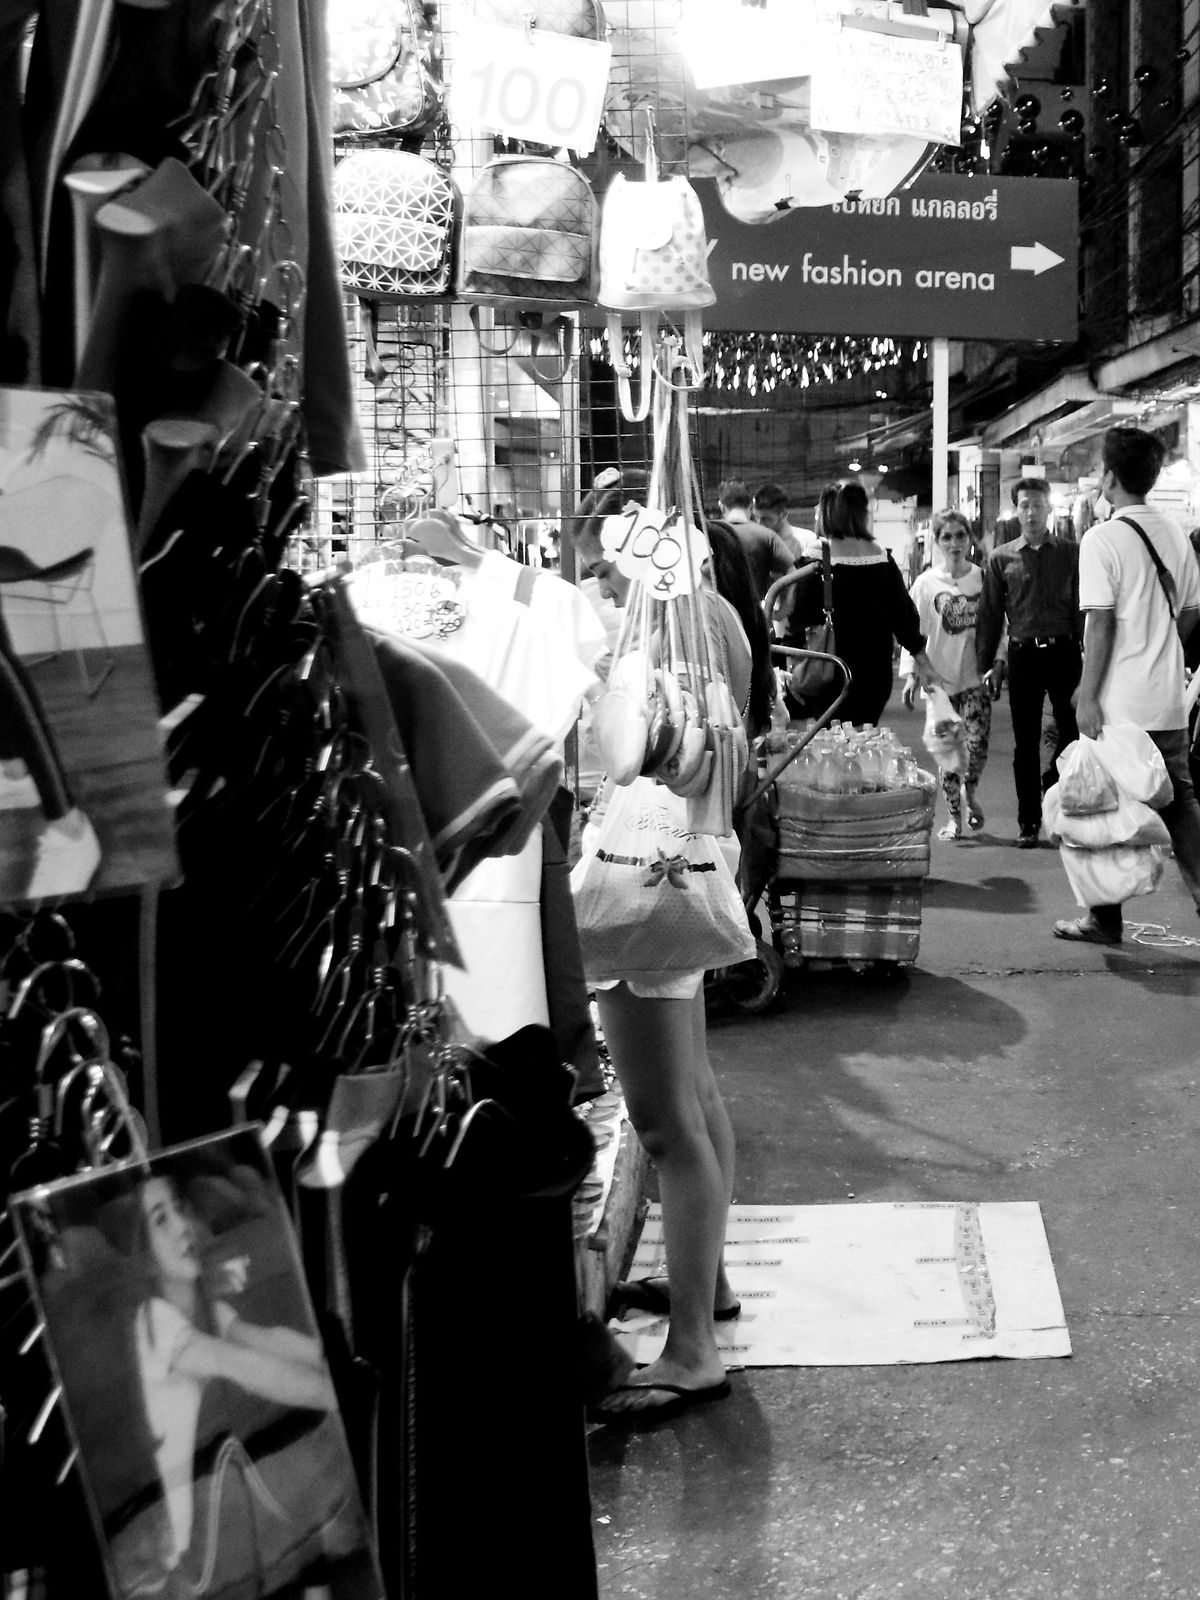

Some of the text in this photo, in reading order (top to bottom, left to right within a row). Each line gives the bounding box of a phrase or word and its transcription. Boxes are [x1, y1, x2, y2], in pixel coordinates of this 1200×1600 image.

[470, 61, 586, 137] 100
[911, 188, 998, 221] แกลลอรี่
[731, 253, 995, 292] new fashion arena
[614, 509, 682, 571] 100
